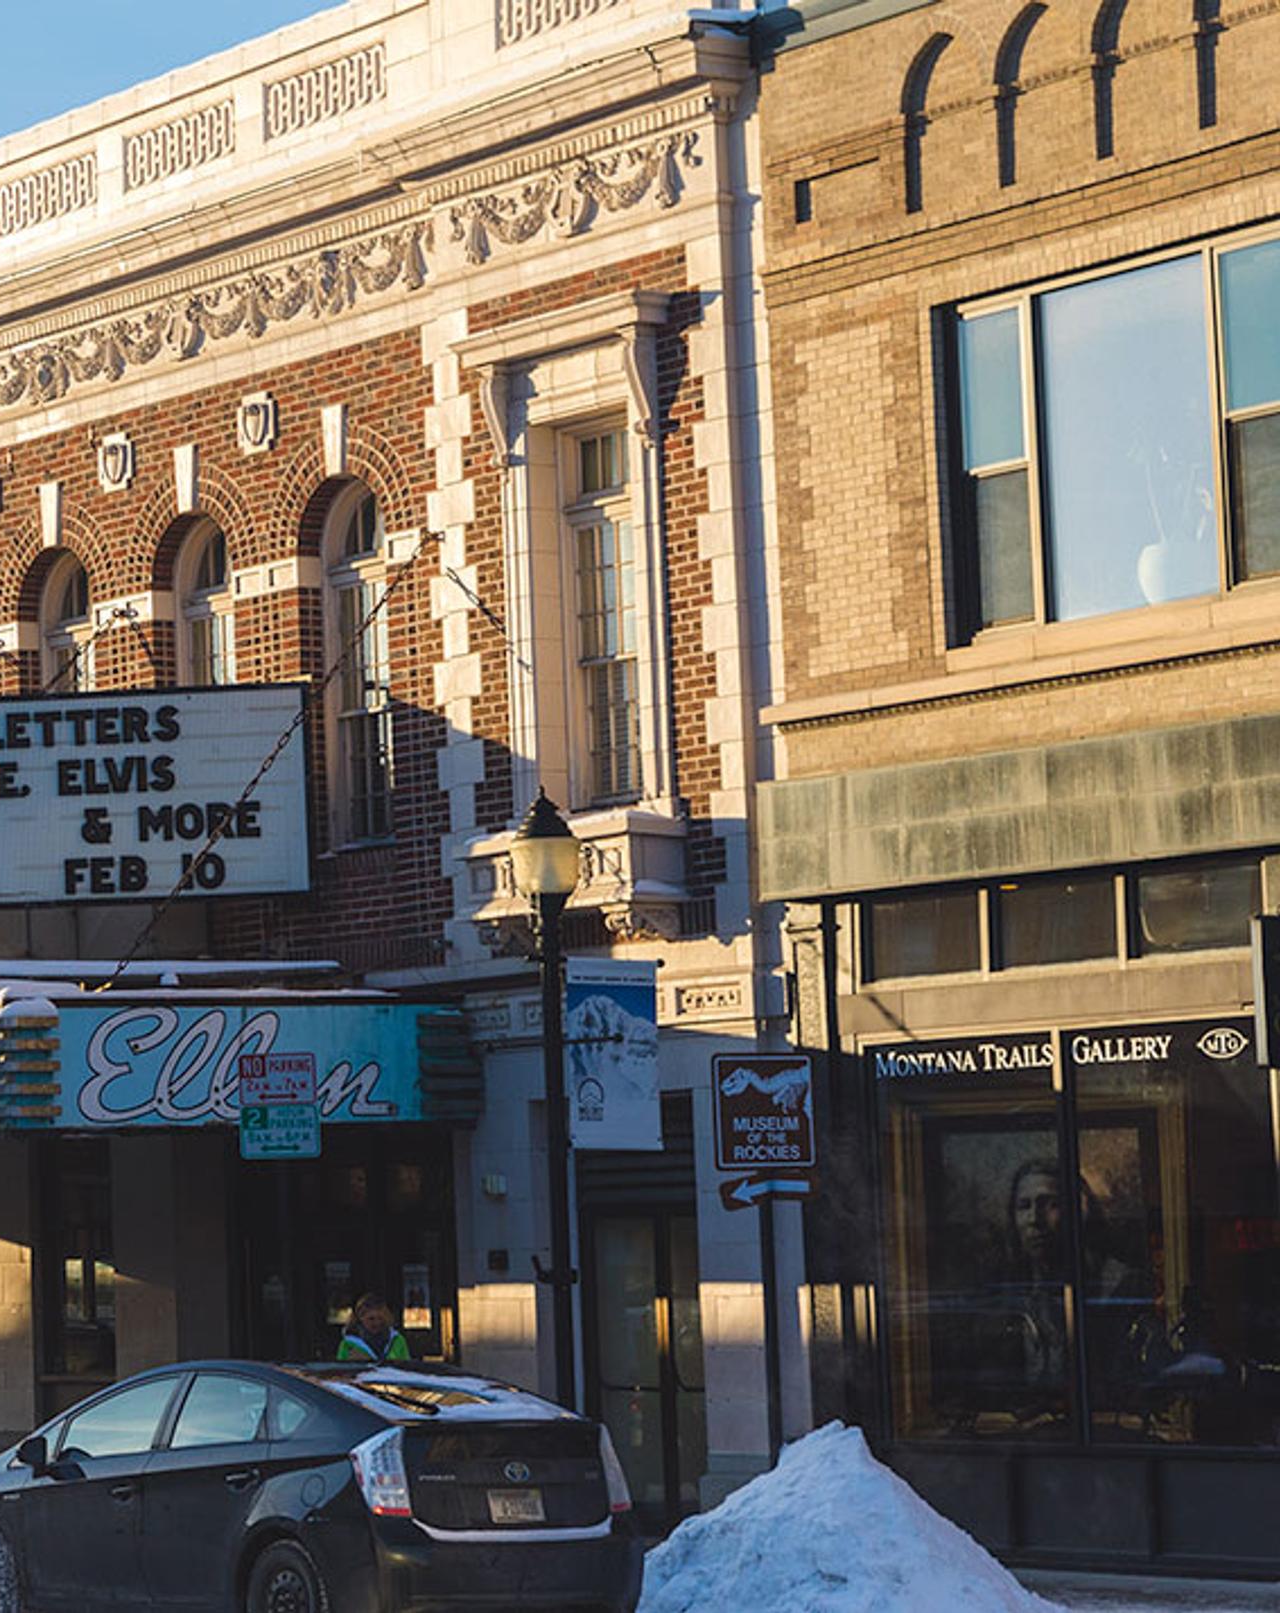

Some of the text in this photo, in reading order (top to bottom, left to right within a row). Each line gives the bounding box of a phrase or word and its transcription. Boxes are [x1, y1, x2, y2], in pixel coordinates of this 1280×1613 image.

[57, 755, 176, 796] ELVIS
[81, 807, 112, 845] &
[138, 800, 262, 843] MORE
[64, 855, 148, 895] FEB
[76, 1004, 398, 1124] Elln
[241, 1056, 265, 1077] NO
[247, 1107, 262, 1127] 2
[733, 1116, 800, 1131] MUSEUM
[747, 1132, 786, 1144] OF THE
[734, 1145, 801, 1160] ROCKIES
